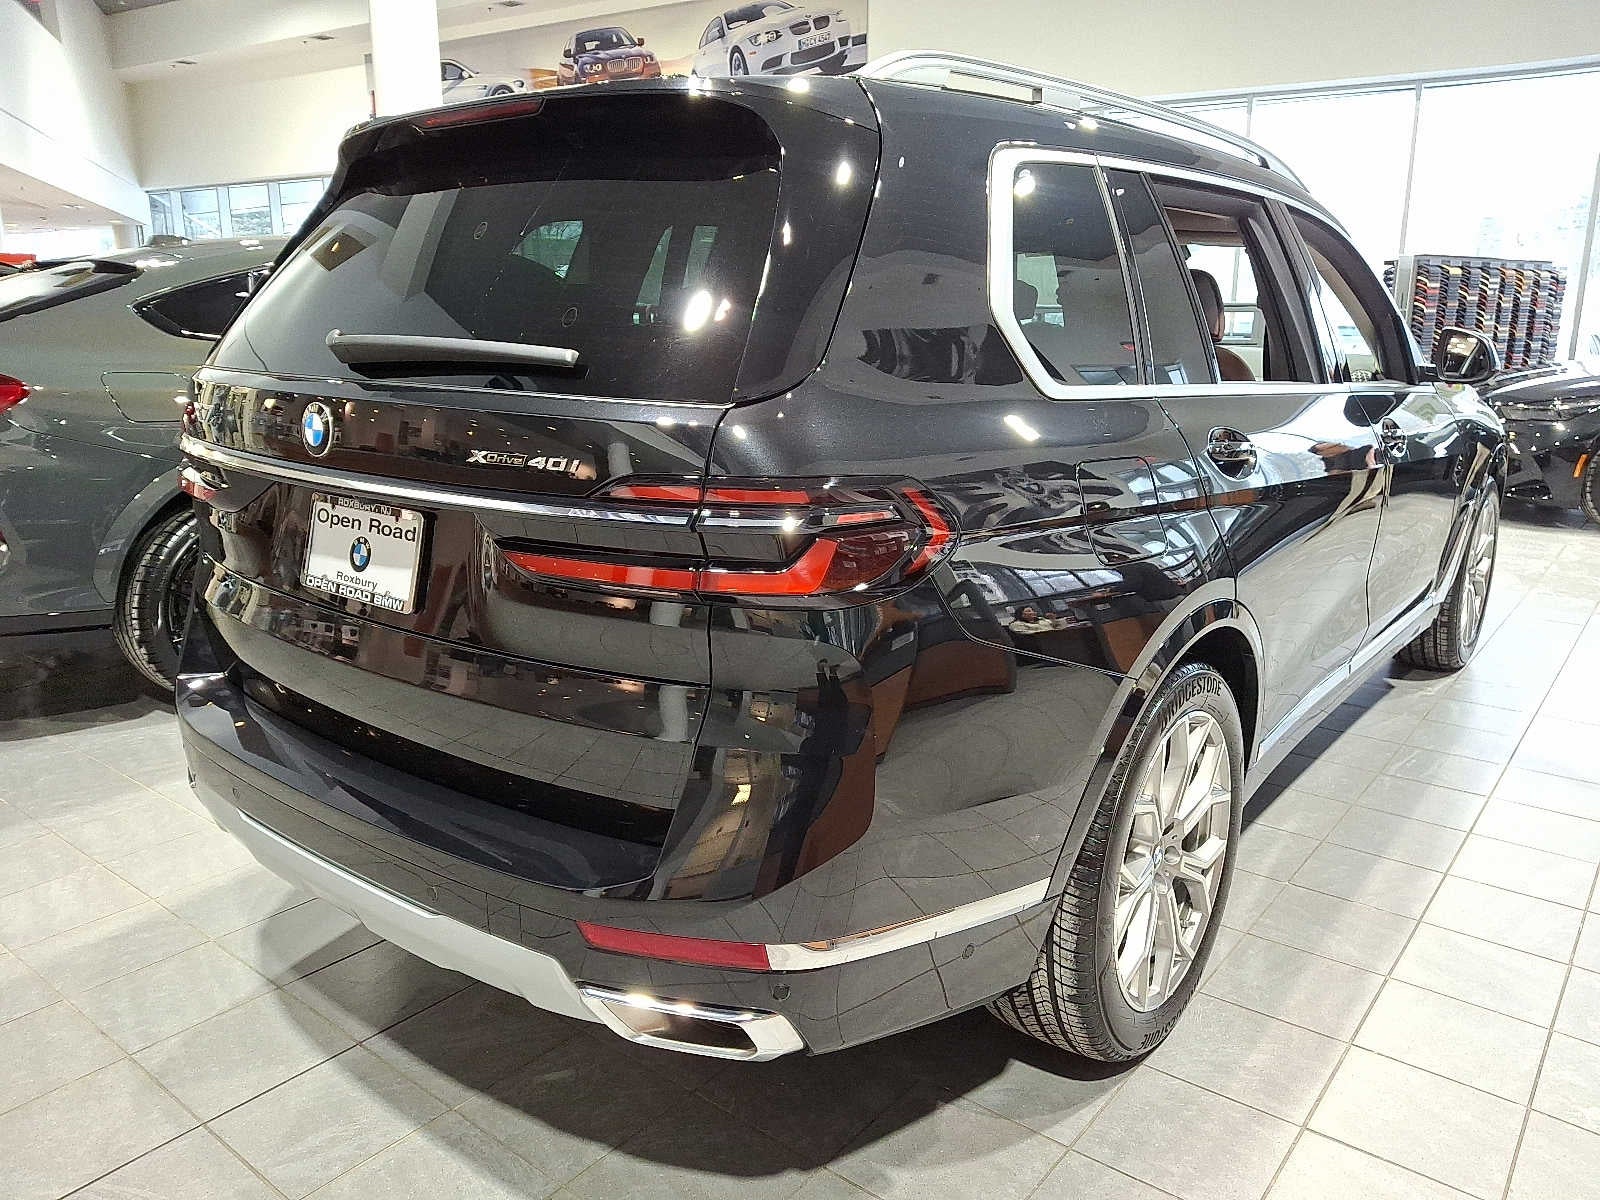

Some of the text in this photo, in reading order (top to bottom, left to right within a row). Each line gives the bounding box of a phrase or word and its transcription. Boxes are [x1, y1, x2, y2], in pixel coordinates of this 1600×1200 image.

[380, 504, 392, 515] NJ
[317, 507, 416, 542] Open Road
[306, 575, 404, 611] OPEN ROAD BMW
[336, 571, 378, 592] Roxbury
